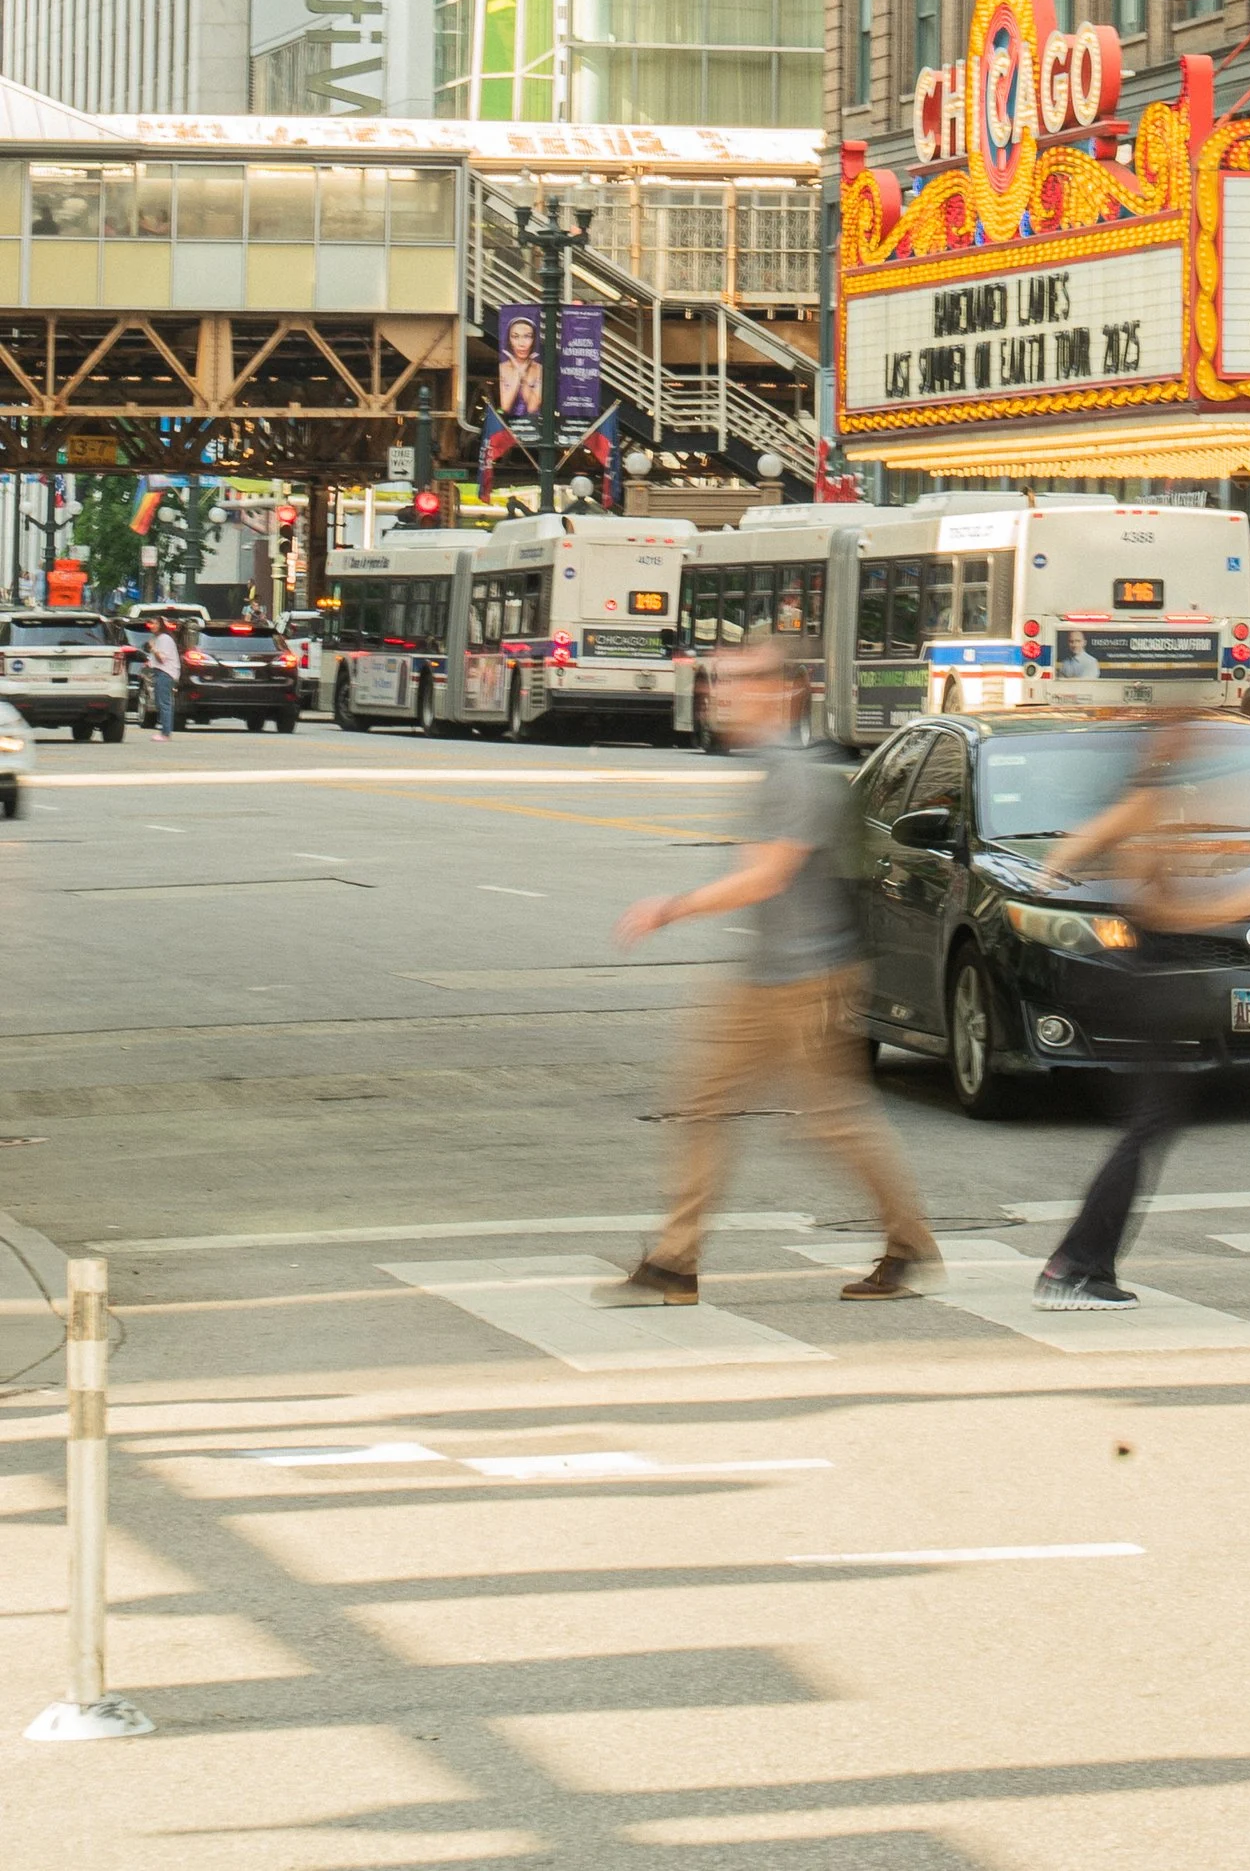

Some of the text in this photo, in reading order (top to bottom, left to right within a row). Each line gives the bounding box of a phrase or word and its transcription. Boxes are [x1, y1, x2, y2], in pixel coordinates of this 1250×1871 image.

[913, 20, 1103, 164] CHICAGO
[885, 351, 912, 399] LAST
[1001, 333, 1046, 386] EARTH
[1055, 327, 1092, 381] TOUR
[391, 449, 413, 458] ONE
[635, 593, 662, 610] 146
[1122, 582, 1155, 602] 146
